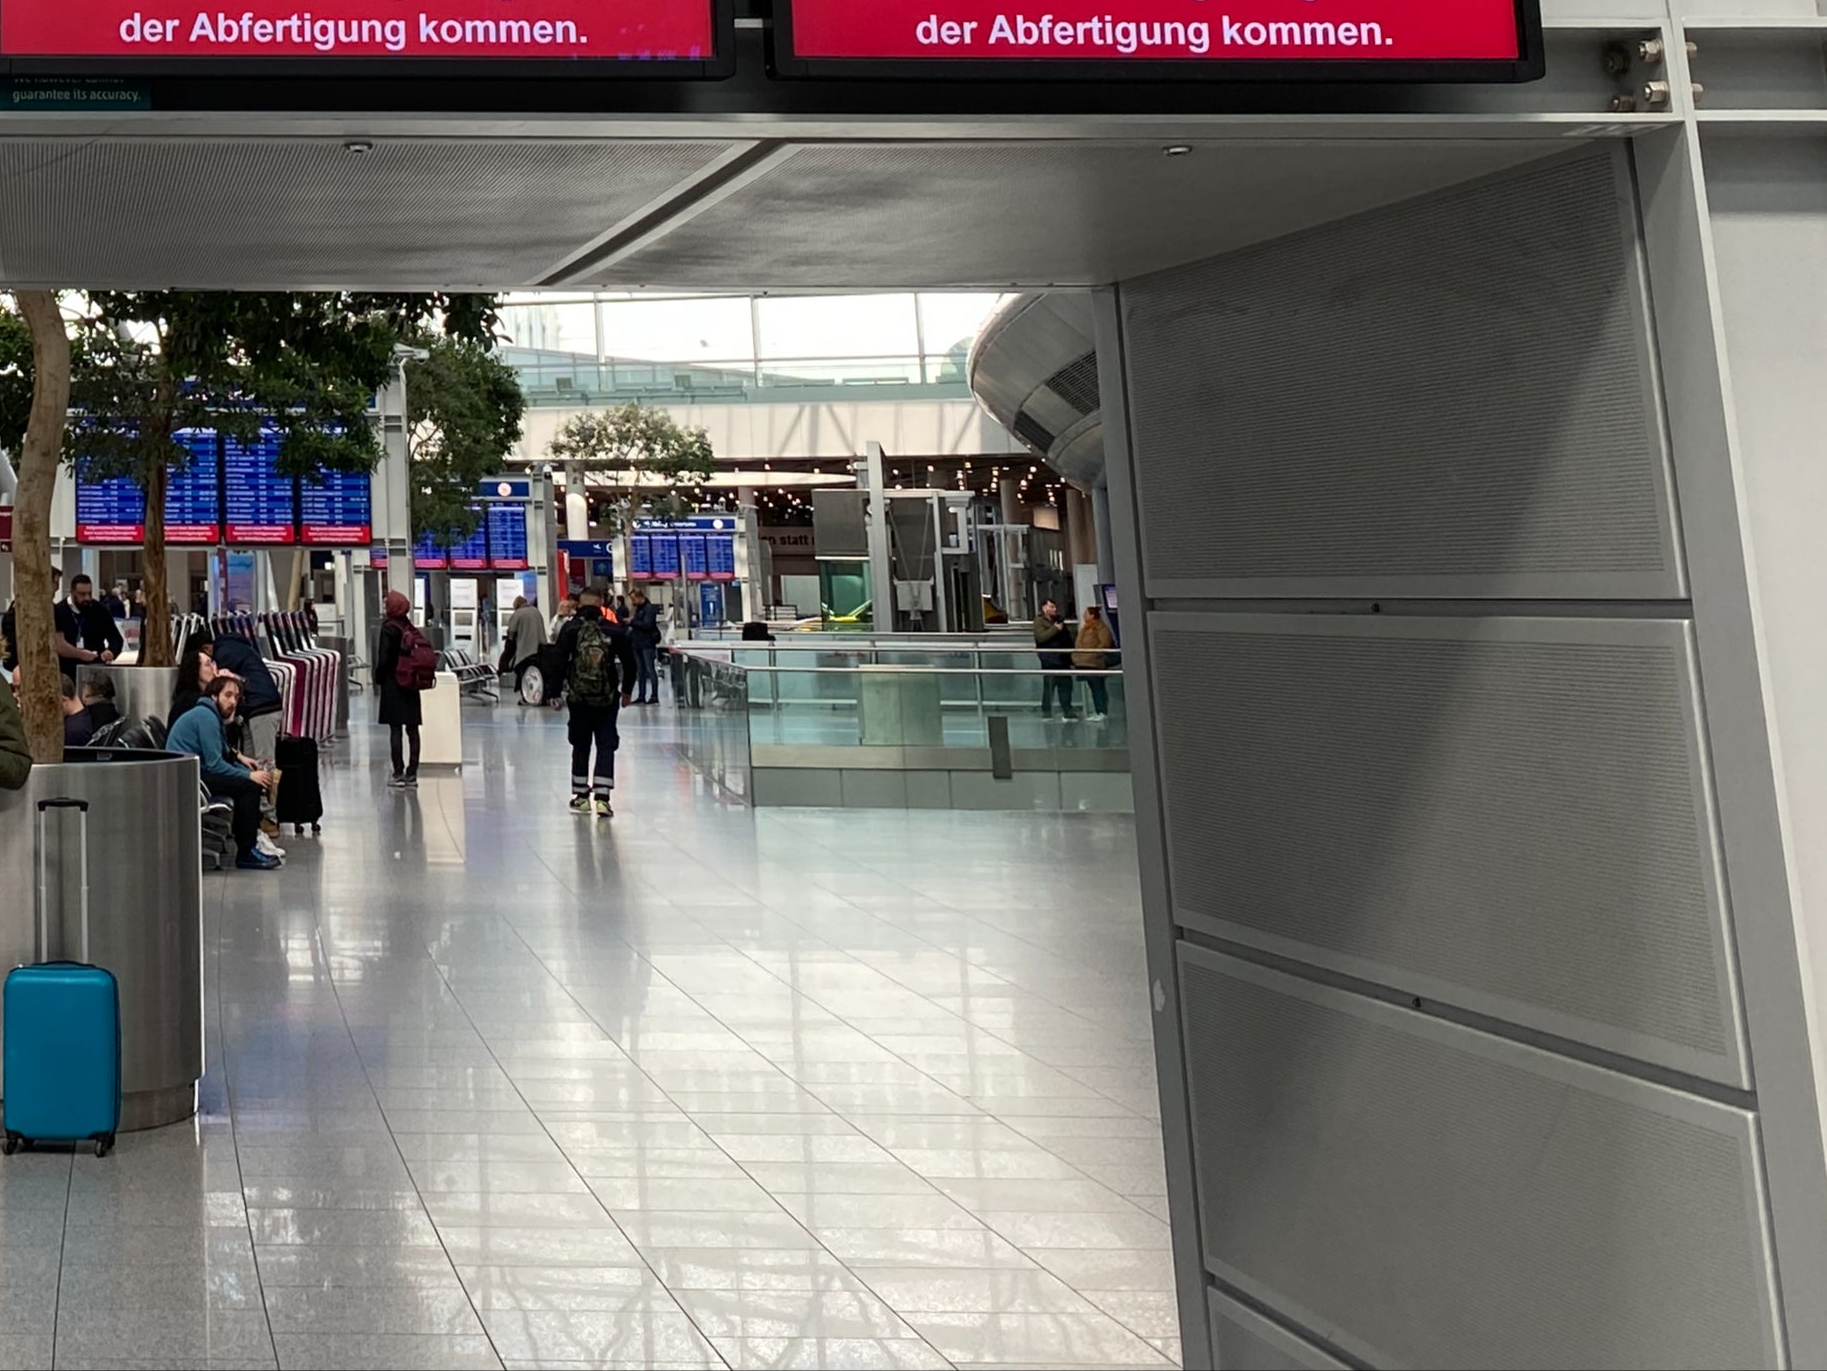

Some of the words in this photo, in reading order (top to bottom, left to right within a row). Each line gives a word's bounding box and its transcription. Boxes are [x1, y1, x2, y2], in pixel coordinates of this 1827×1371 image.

[916, 15, 977, 44] der
[989, 15, 1209, 53] Abfertigung
[1222, 15, 1392, 45] kommen.
[12, 89, 71, 102] guarantee
[780, 534, 810, 546] statt
